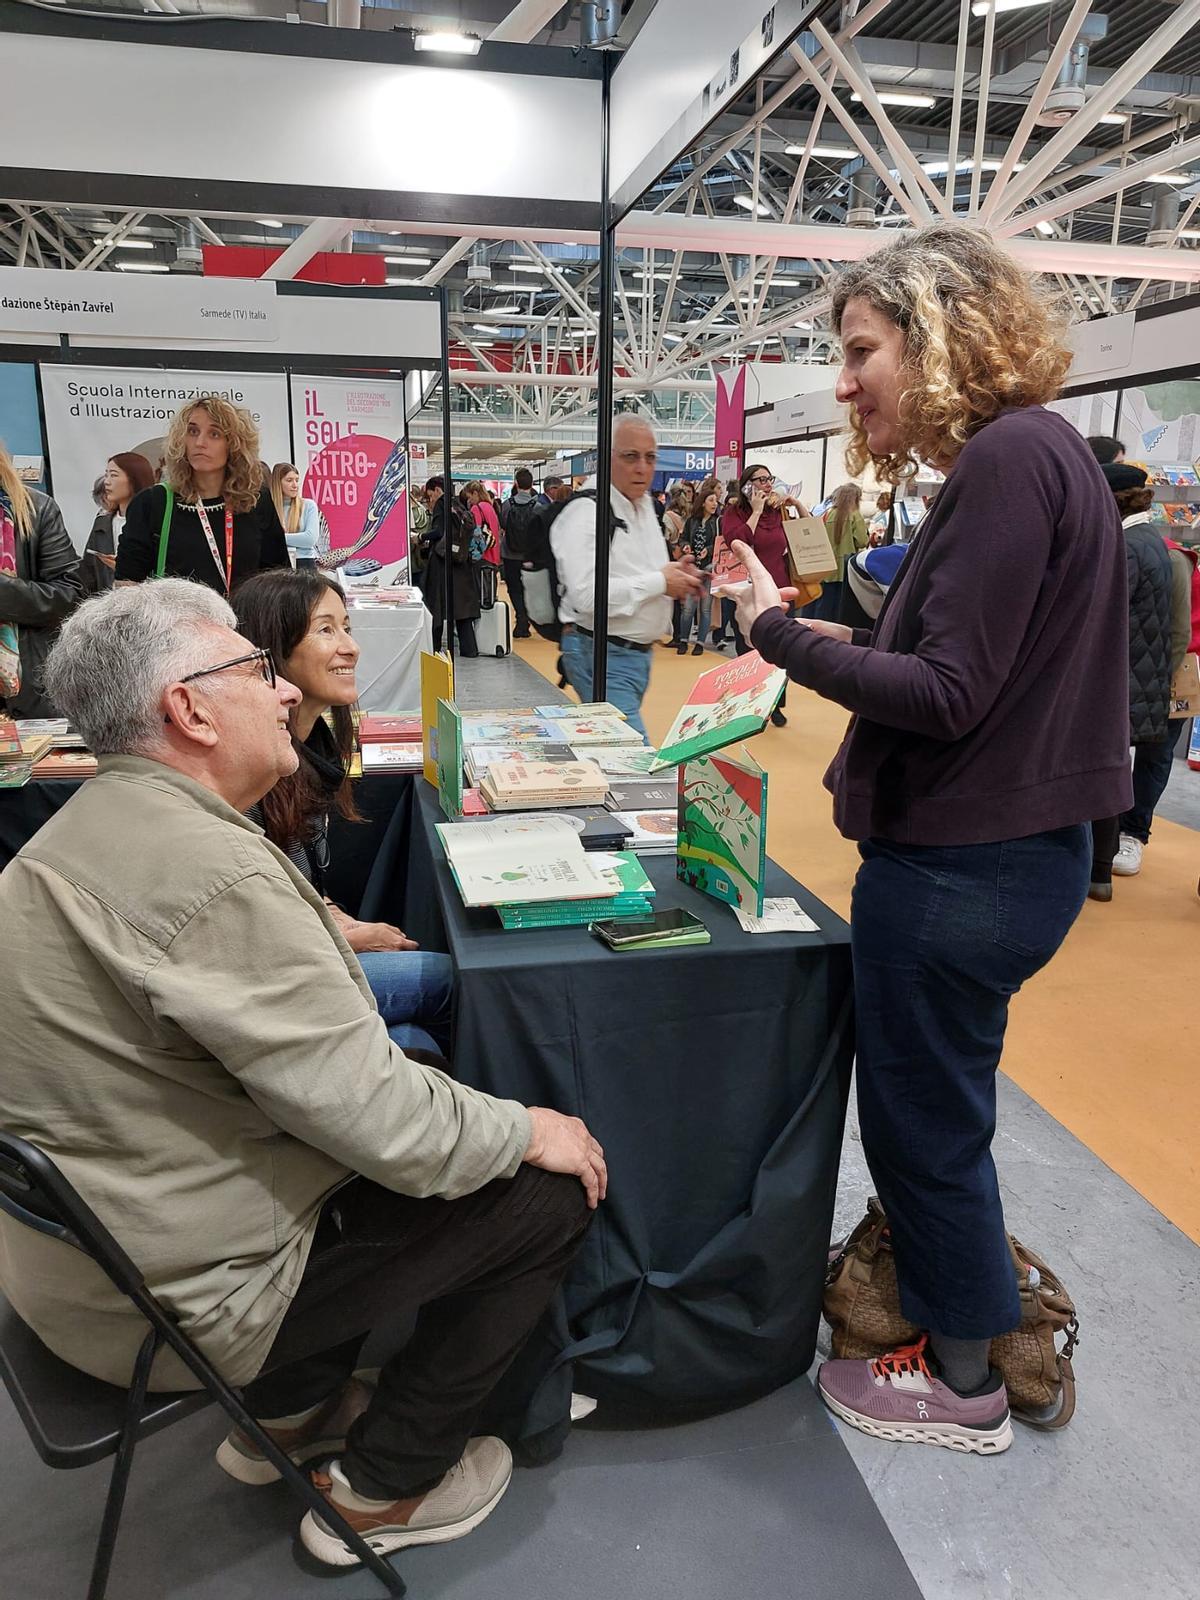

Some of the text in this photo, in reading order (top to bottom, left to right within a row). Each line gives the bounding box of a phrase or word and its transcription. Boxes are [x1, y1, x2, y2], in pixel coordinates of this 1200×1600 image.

[82, 301, 114, 312] Zavřel
[200, 308, 266, 319] Sarmede (TV) Italia
[67, 382, 244, 401] Scuola Internazionale
[306, 420, 360, 447] SOLE
[730, 440, 738, 451] B
[308, 479, 358, 506] VATO
